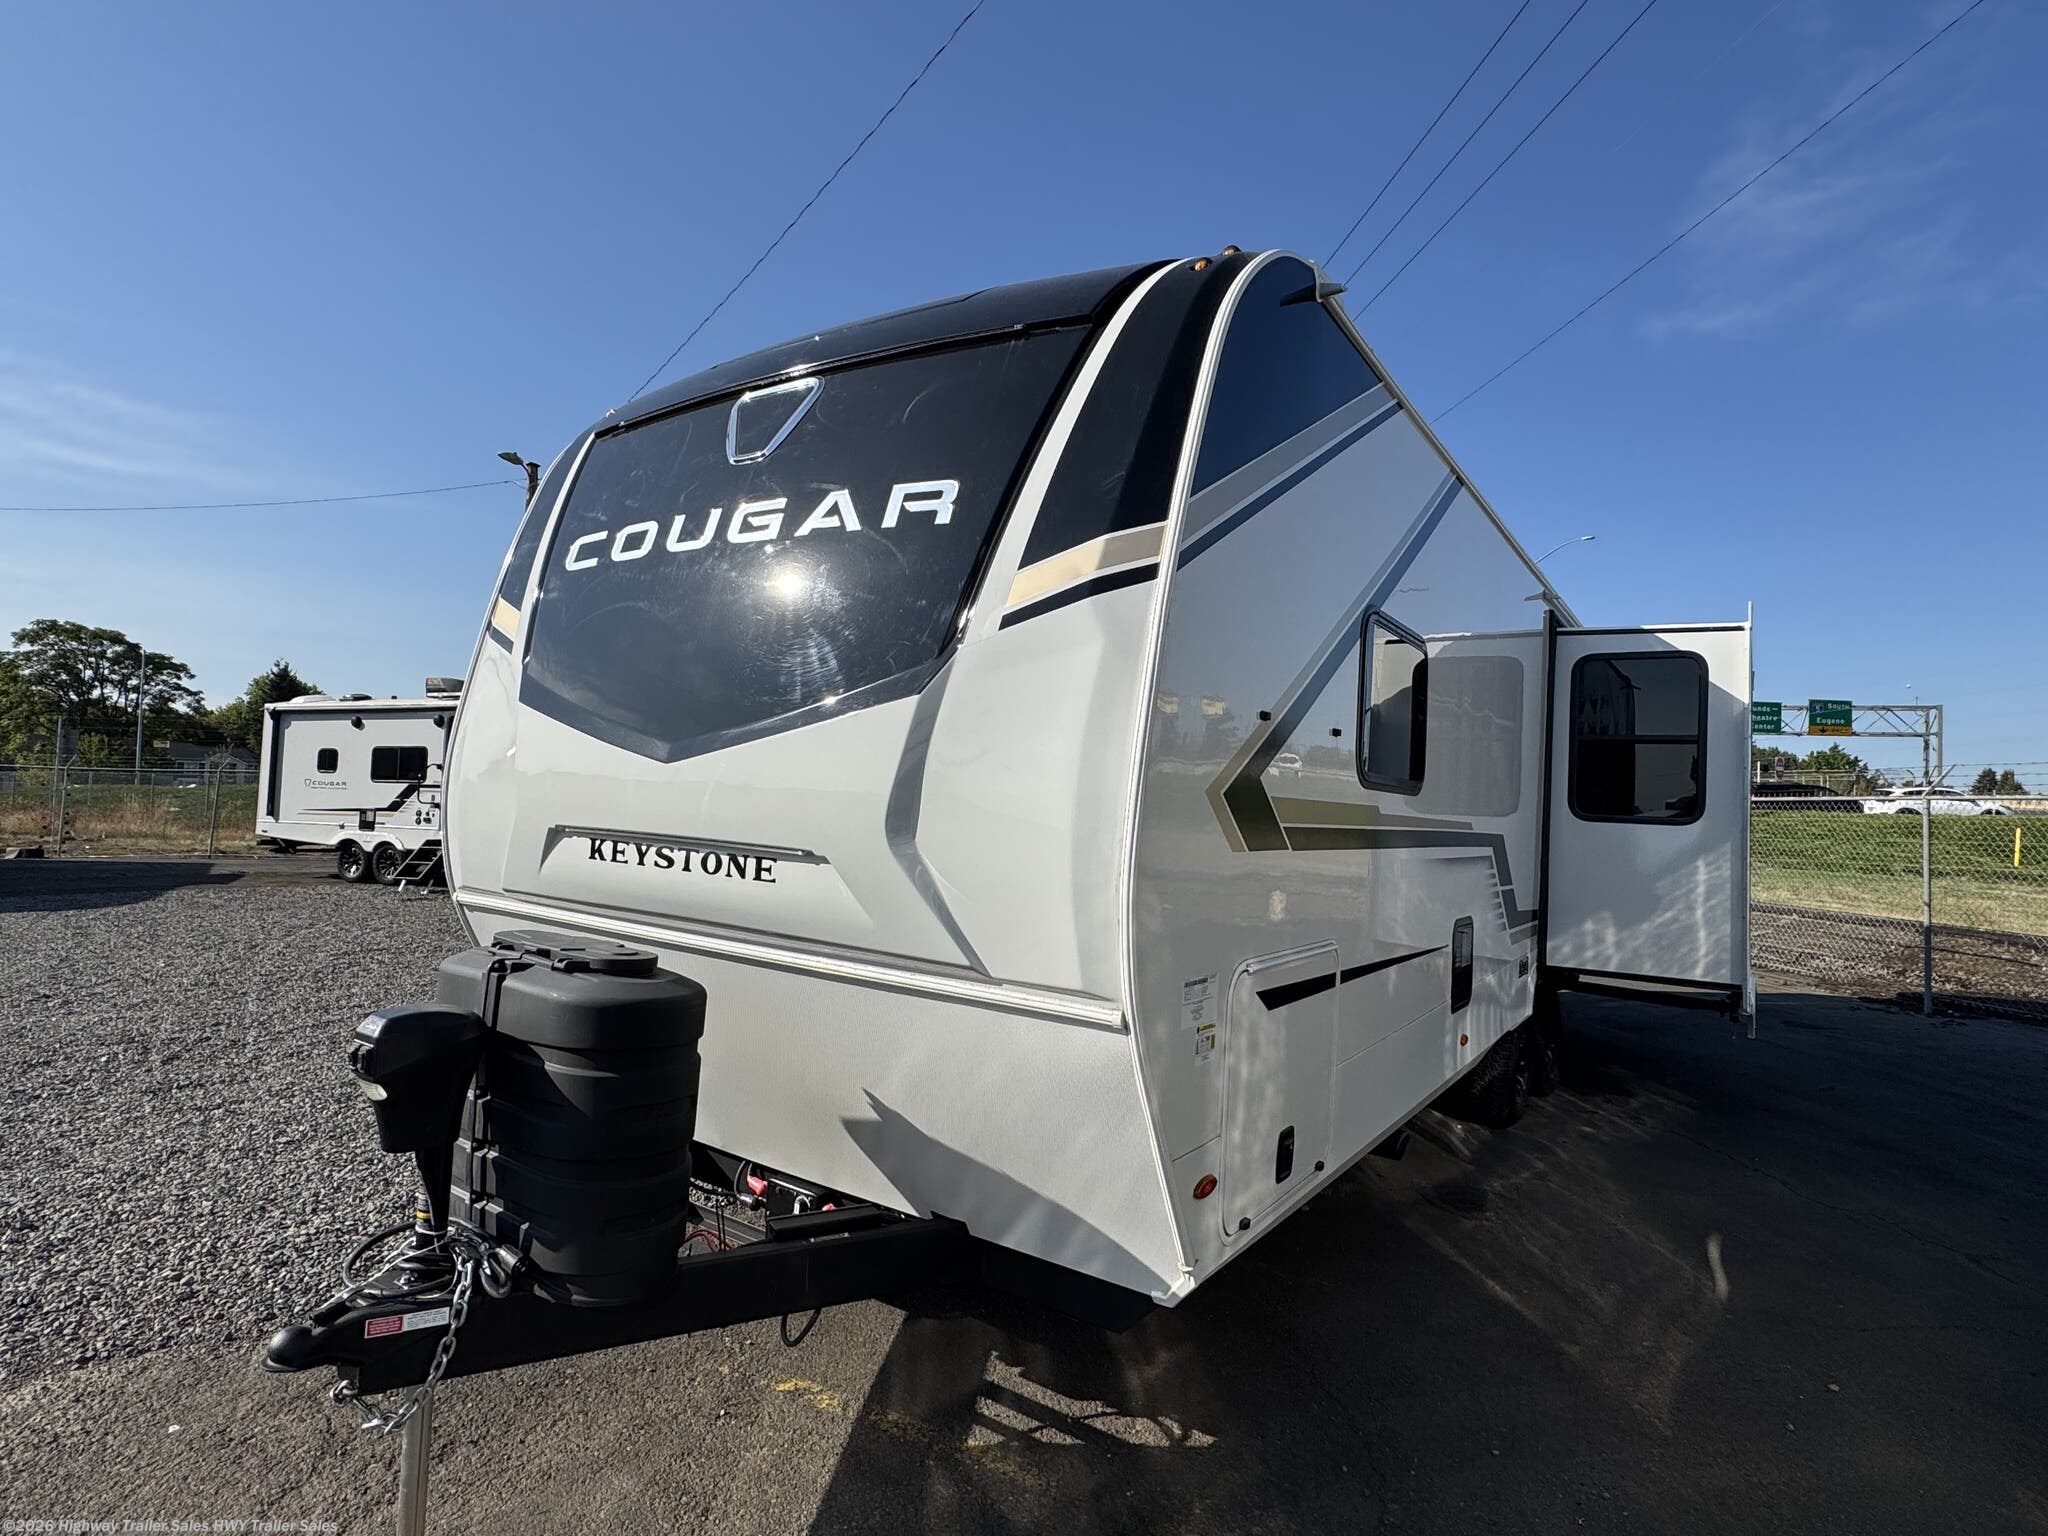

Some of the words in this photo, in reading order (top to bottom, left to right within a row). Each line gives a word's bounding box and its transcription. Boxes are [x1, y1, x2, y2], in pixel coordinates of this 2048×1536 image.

[565, 479, 961, 572] COUGAR
[1816, 717, 1845, 725] Eugene
[588, 838, 777, 885] KEYSTONE
